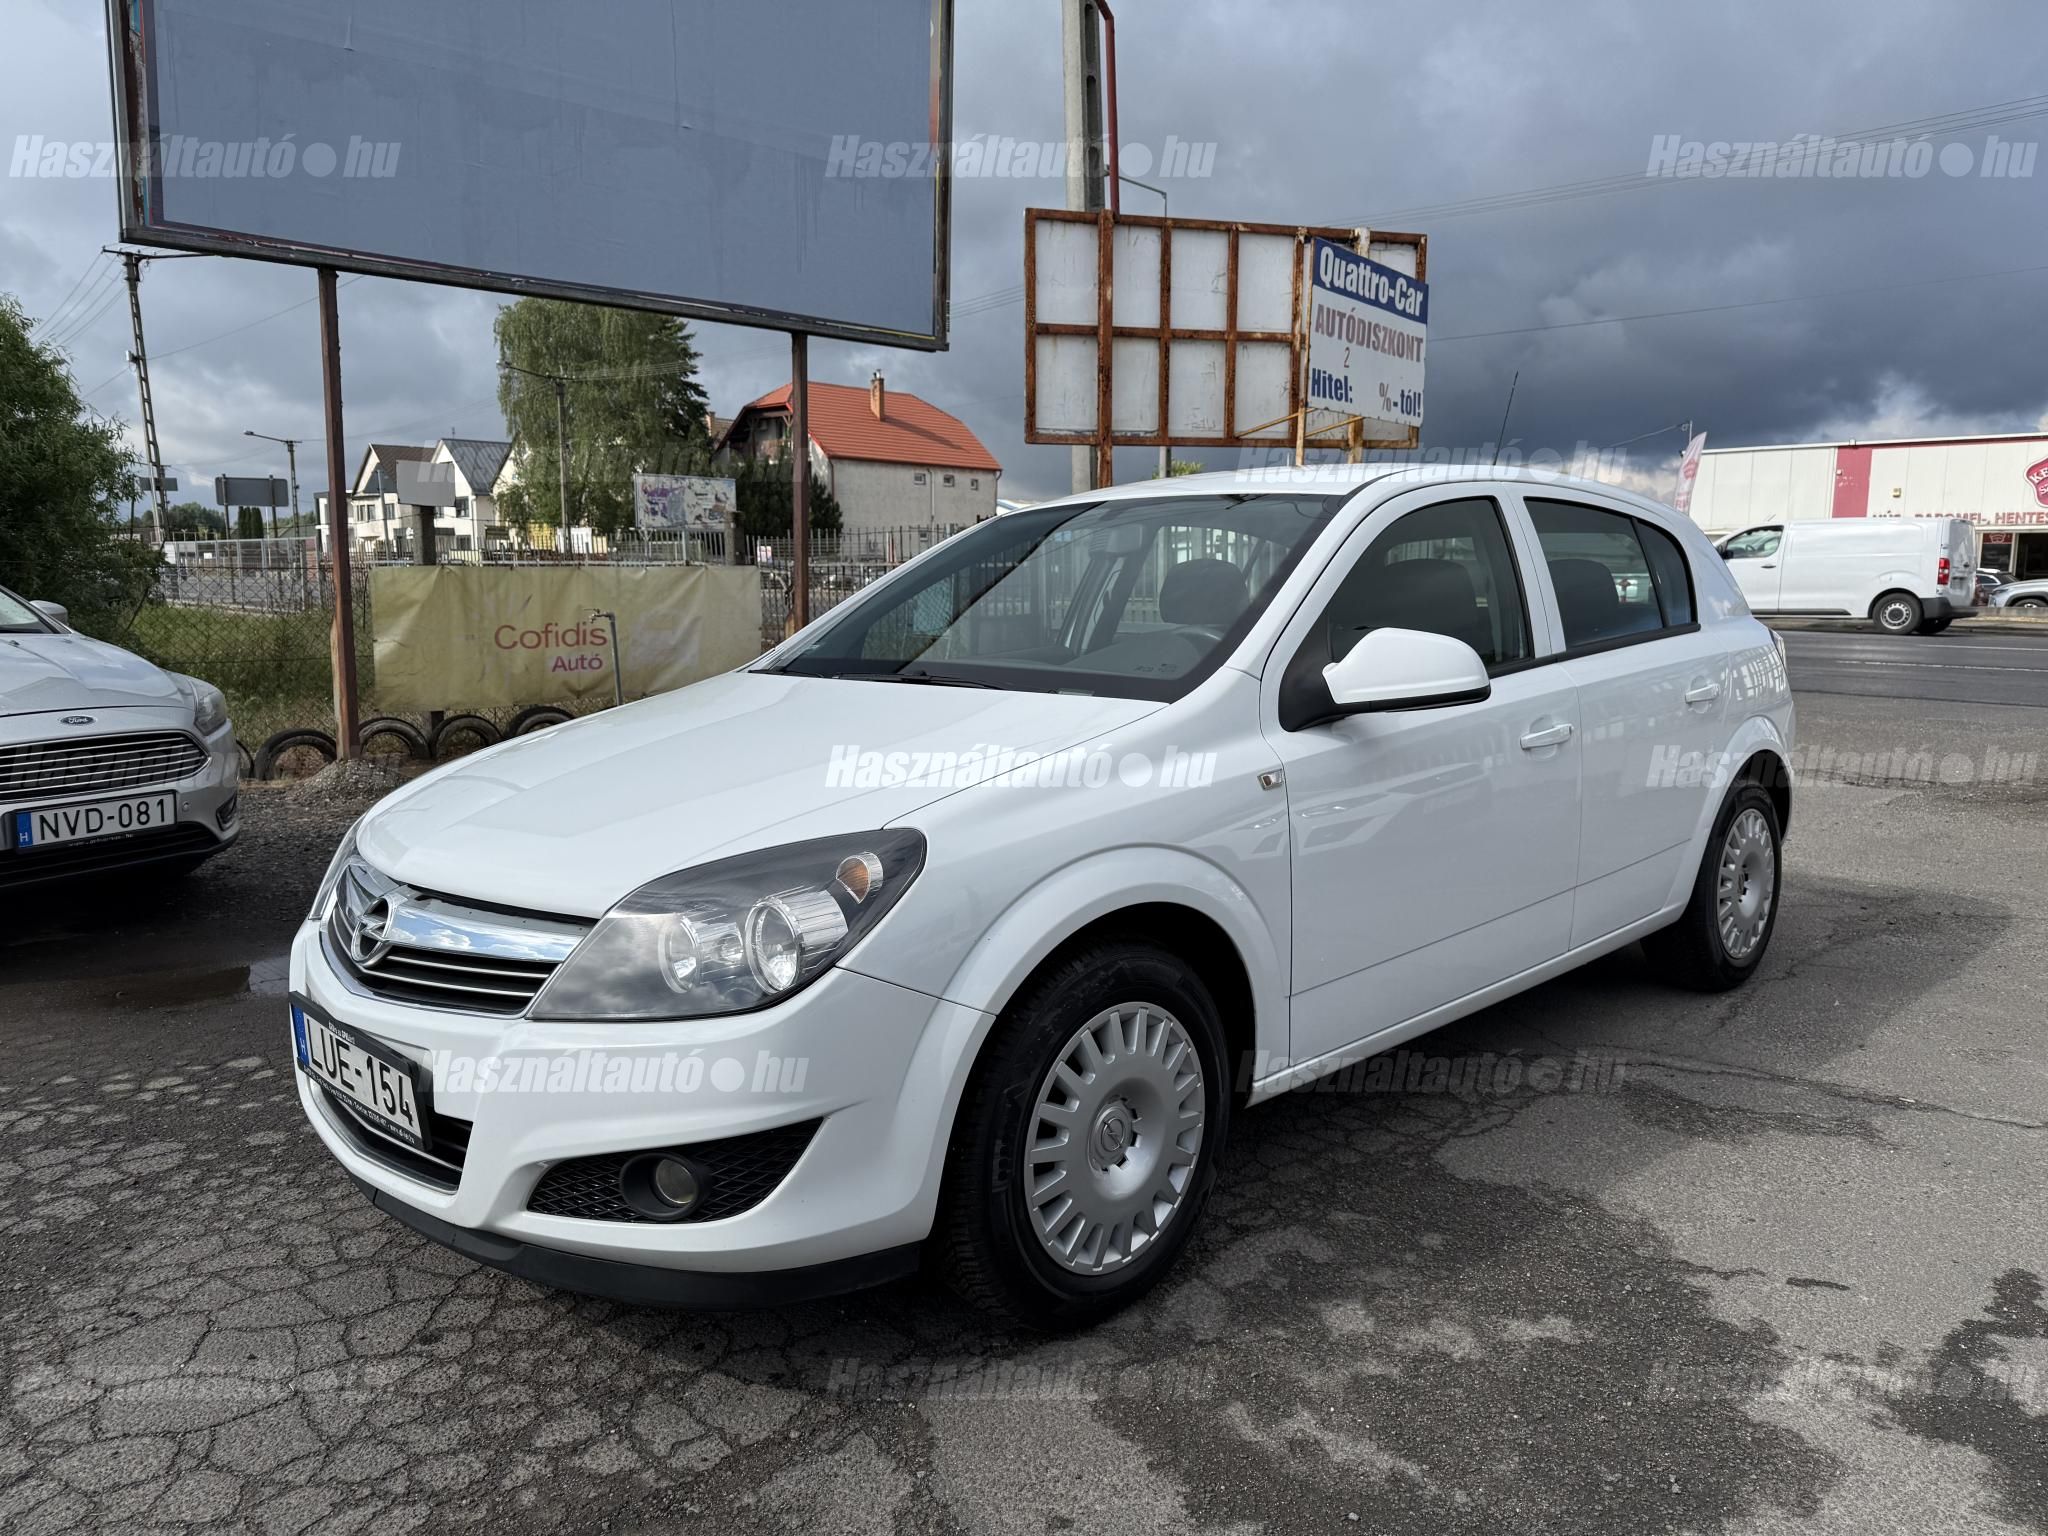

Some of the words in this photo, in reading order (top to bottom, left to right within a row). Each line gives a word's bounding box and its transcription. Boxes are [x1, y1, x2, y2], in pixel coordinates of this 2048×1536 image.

[1319, 245, 1424, 317] Quattro-Car
[1315, 303, 1424, 363] AUTÓDISZKONT
[1311, 367, 1353, 404] Hitel:
[494, 621, 608, 650] Cofidis
[551, 652, 604, 673] Autó
[19, 832, 29, 842] H
[39, 798, 166, 841] NVD-081
[306, 1017, 415, 1129] LUE-154
